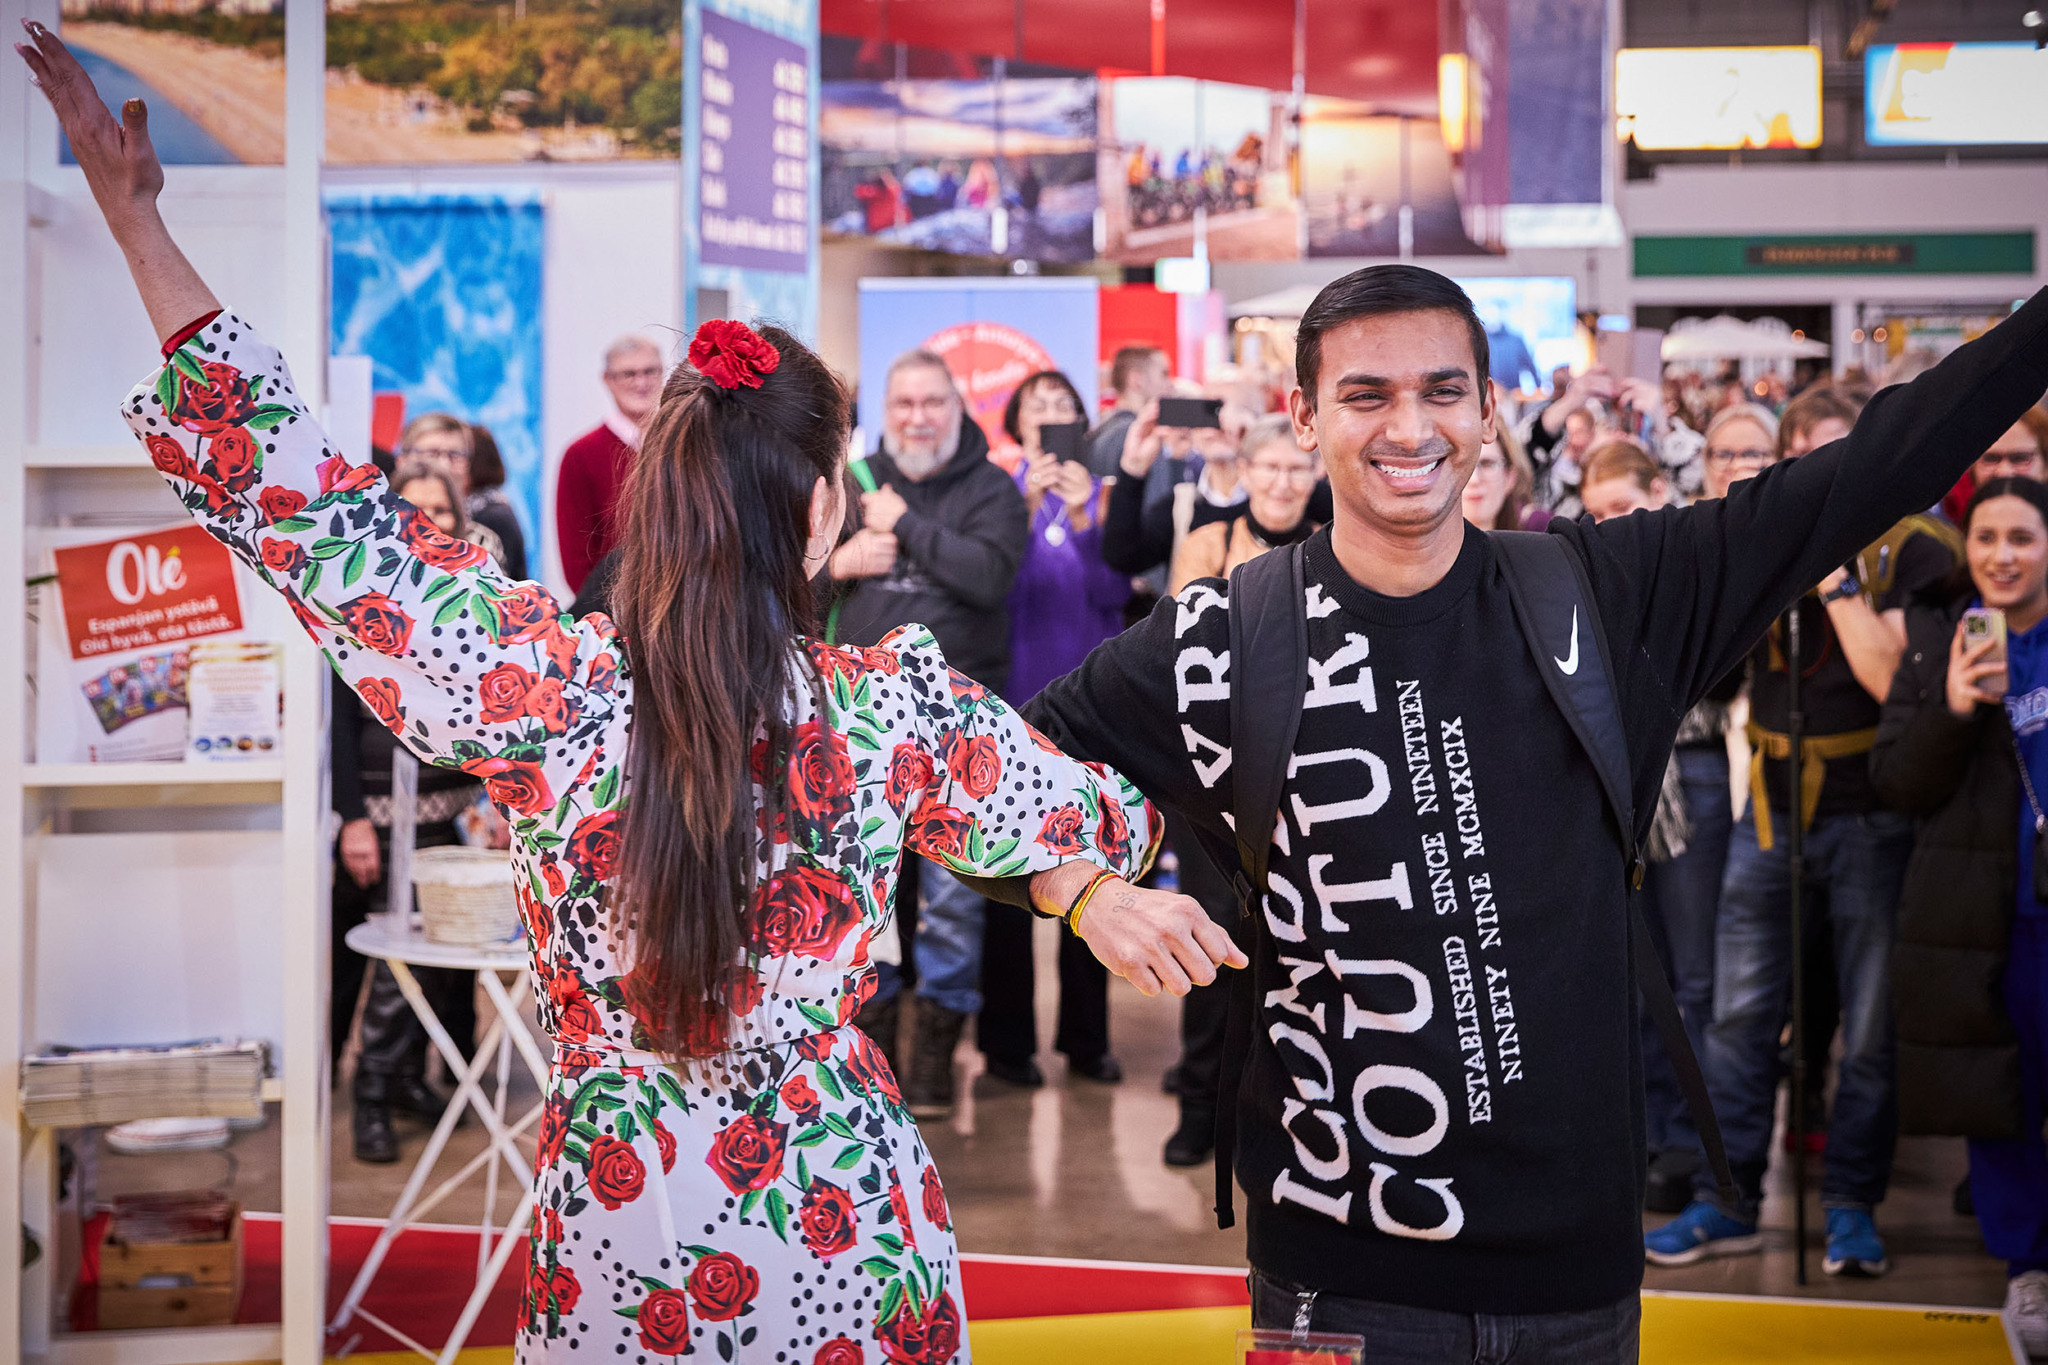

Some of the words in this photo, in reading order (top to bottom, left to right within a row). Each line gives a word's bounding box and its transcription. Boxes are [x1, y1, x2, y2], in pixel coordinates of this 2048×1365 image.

[106, 541, 187, 605] Olé
[1396, 679, 1439, 816] NINETEEN
[1441, 716, 1485, 859] MCMXCIX
[1422, 832, 1458, 915] SINCE
[1468, 873, 1502, 950] NINE
[1443, 936, 1491, 1124] ESTABLISHED
[1485, 965, 1523, 1084] NINETY
